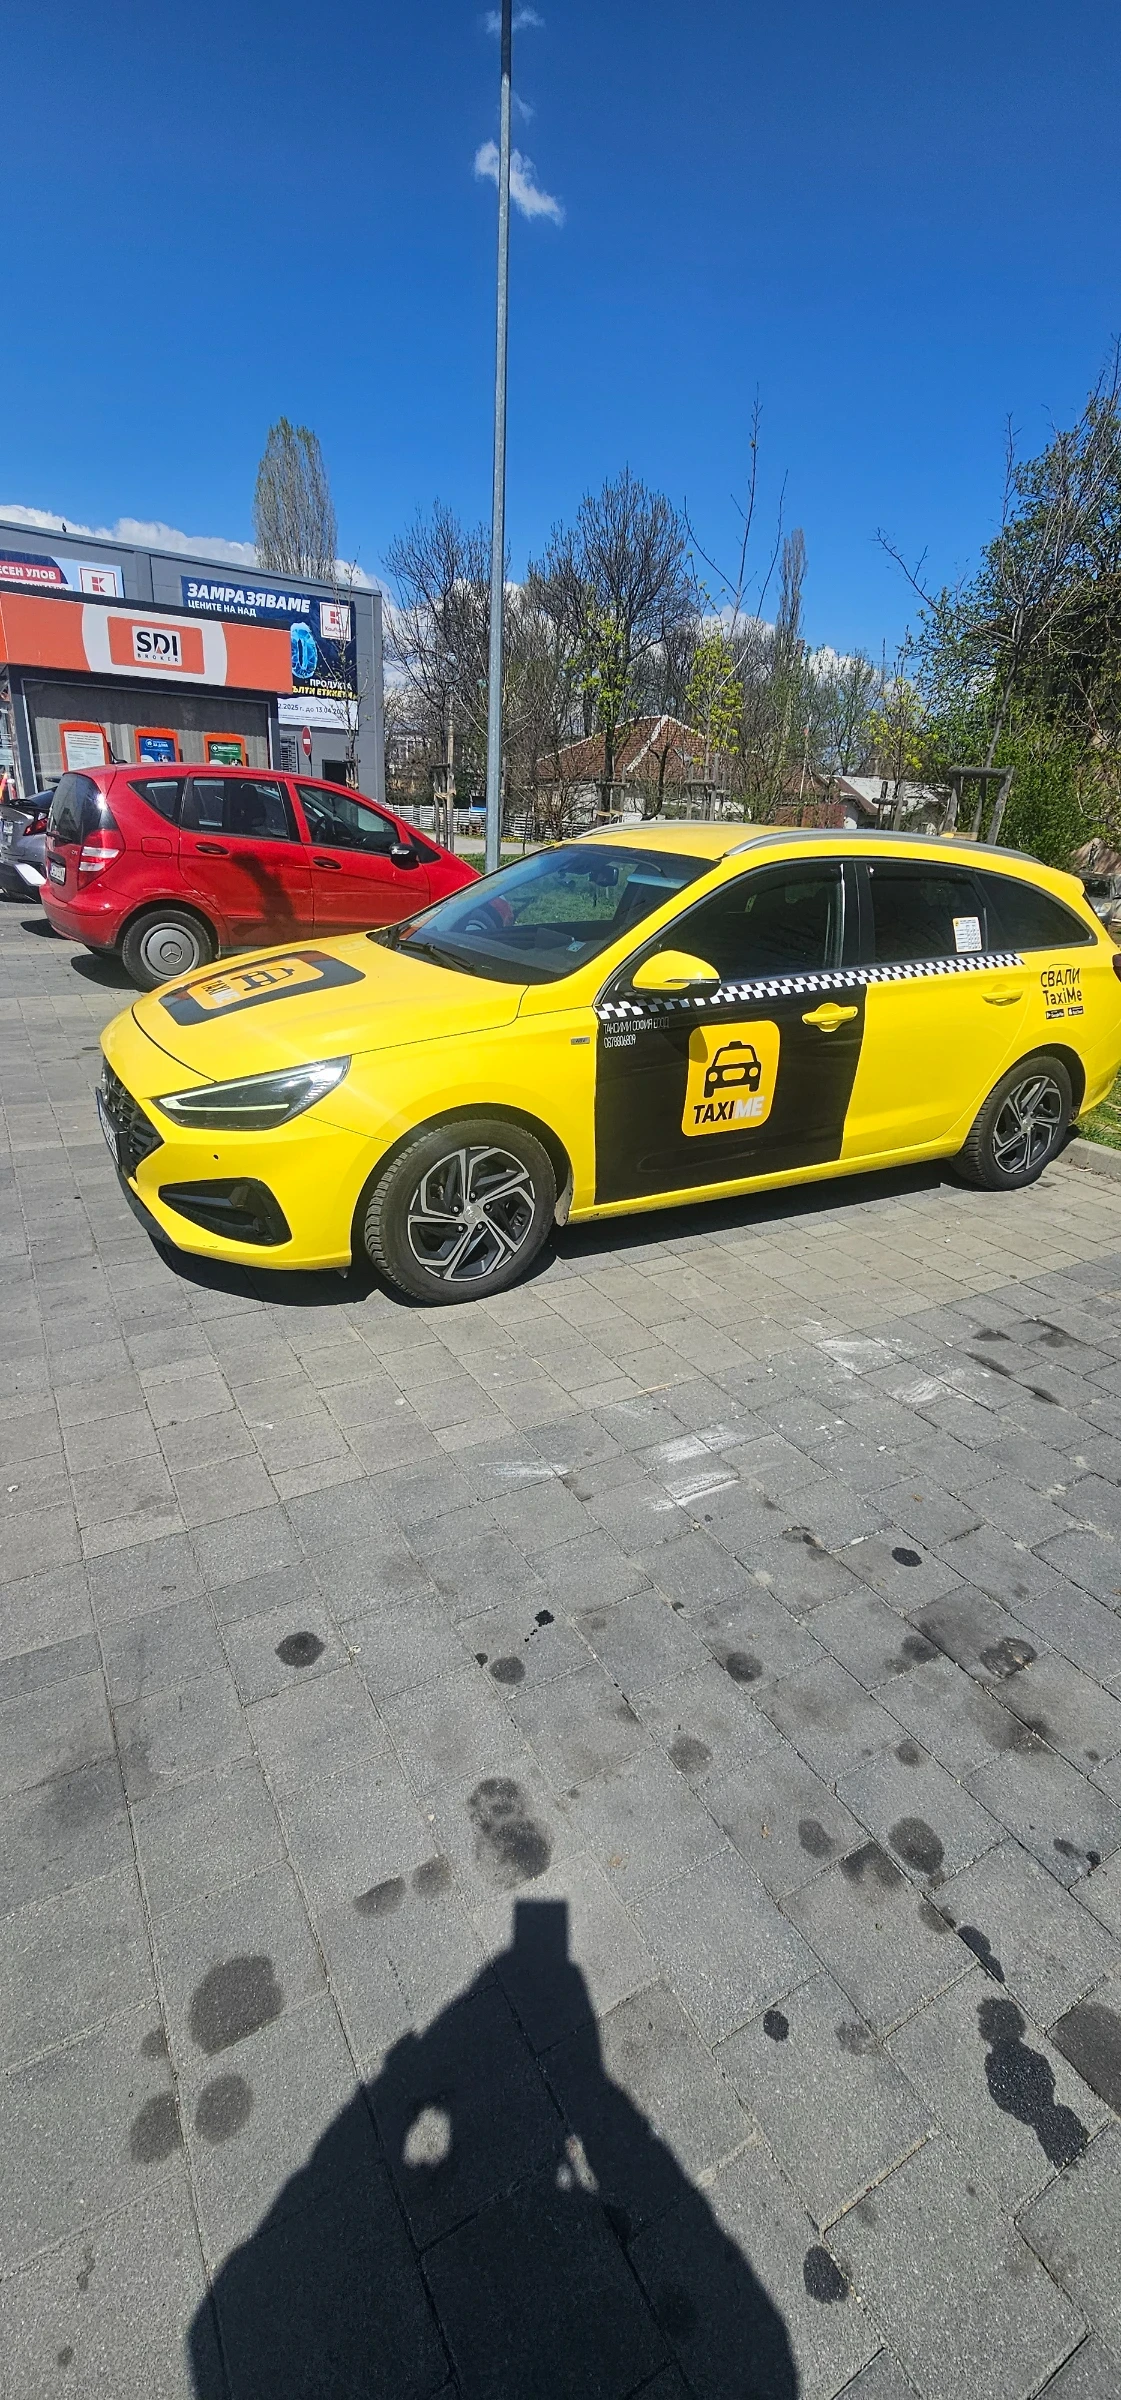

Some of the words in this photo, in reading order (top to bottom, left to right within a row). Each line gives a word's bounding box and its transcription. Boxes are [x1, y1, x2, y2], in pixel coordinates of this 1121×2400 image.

[25, 568, 57, 580] УЛОВ
[187, 583, 311, 613] ЗАМРАЗЯВАМЕ
[188, 600, 222, 612] ЦЕНИТЕ
[223, 605, 236, 614] НА
[237, 608, 257, 617] НАД
[136, 631, 178, 656] SDI
[138, 653, 179, 662] BROKER
[1040, 968, 1080, 987] СВАЛИ
[1042, 986, 1082, 1005] TaxiMe
[693, 1095, 765, 1124] TAXIME
